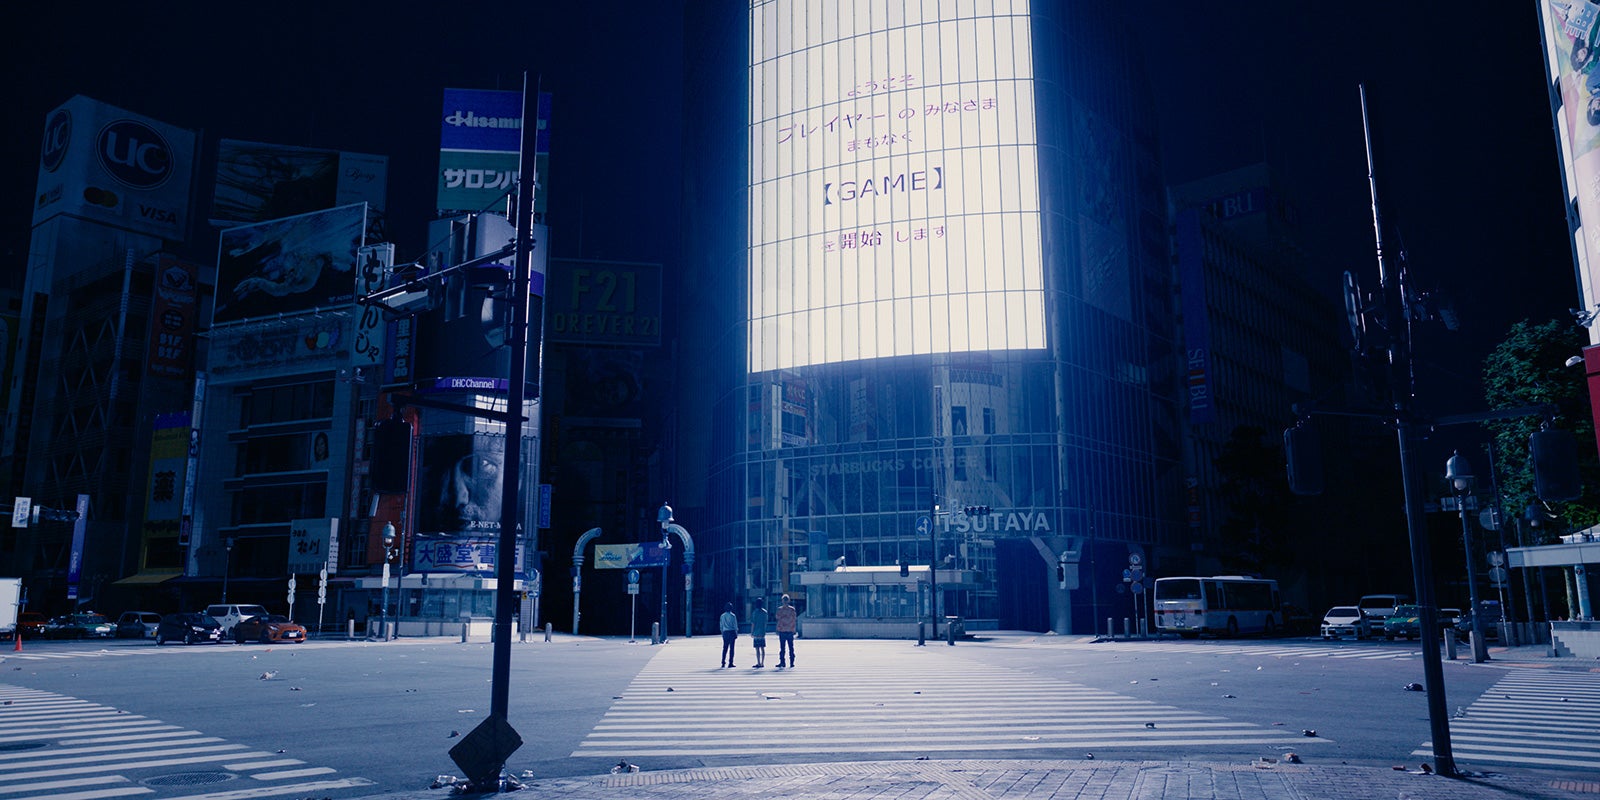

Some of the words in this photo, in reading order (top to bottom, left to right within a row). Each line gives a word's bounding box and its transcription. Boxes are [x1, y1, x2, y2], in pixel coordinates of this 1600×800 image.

[847, 73, 916, 97] ようこそ
[444, 110, 547, 130] Hisamiu
[777, 113, 886, 144] プレイヤー
[898, 107, 916, 120] の
[924, 97, 997, 117] みなさま
[105, 130, 167, 174] UC
[846, 130, 914, 152] まもなく
[139, 204, 177, 225] VISA
[895, 224, 945, 243] します
[571, 268, 636, 313] F21
[553, 313, 635, 336] OREVER
[641, 316, 660, 337] 21
[452, 378, 465, 388] DHC
[466, 378, 495, 389] Channel
[1187, 348, 1209, 411] SEIBU
[810, 456, 906, 476] STARBUCKS
[940, 511, 1051, 533] TSUTAYA
